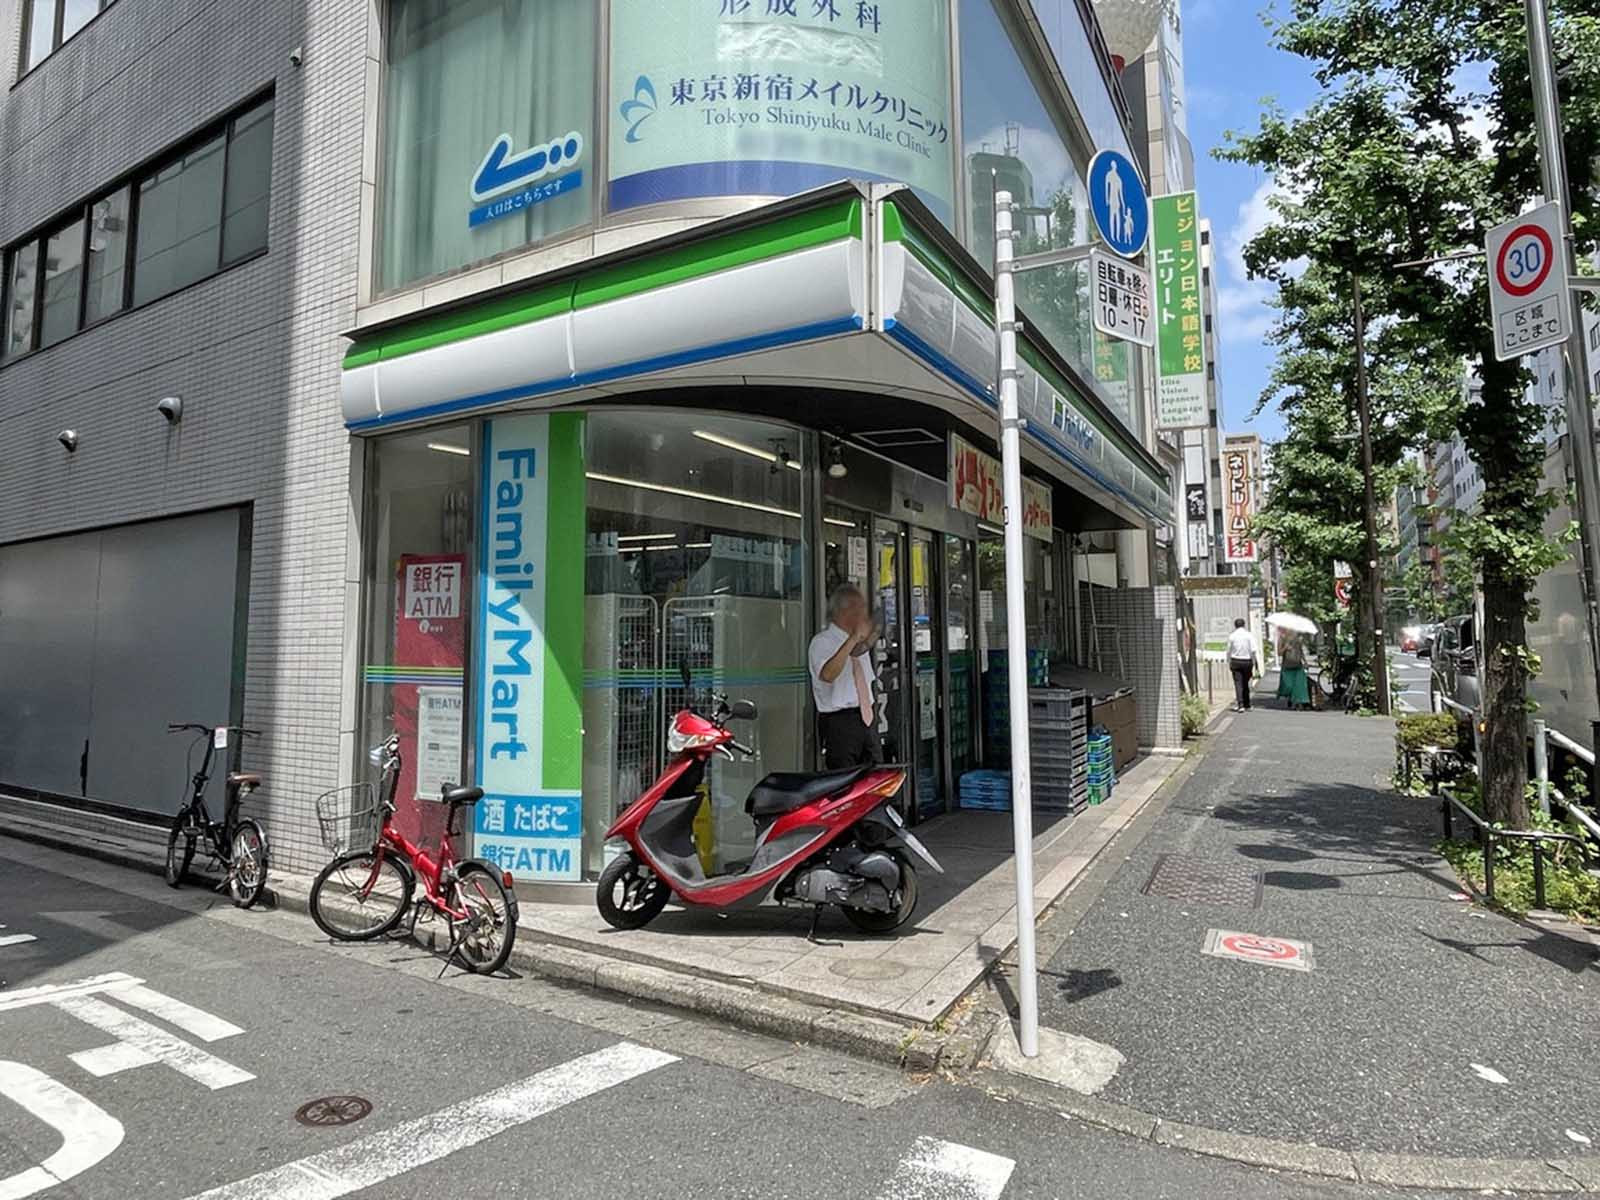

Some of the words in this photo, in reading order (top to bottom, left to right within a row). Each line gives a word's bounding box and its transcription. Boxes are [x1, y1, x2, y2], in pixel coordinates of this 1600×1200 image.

[669, 73, 948, 144] 東京新宿メイルクリニック
[701, 107, 760, 128] Tokyo
[766, 106, 850, 132] Shinjyuku
[856, 120, 893, 143] Male
[896, 130, 931, 159] Clinic
[486, 179, 563, 219] 入口はこちらです
[1097, 260, 1147, 296] 自転車を除く
[1509, 242, 1541, 279] 30
[1157, 248, 1176, 326] エリート
[1175, 197, 1202, 372] ビジョン日本語学校
[1506, 318, 1557, 347] ここまで
[1515, 304, 1544, 326] 区域
[1228, 452, 1248, 531] ネットルーム
[412, 565, 455, 592] 銀行
[411, 596, 452, 616] ATM
[488, 447, 536, 761] FamilyMart
[483, 798, 506, 832] 酒
[513, 803, 569, 832] たばこ
[480, 843, 570, 872] 銀行ATM
